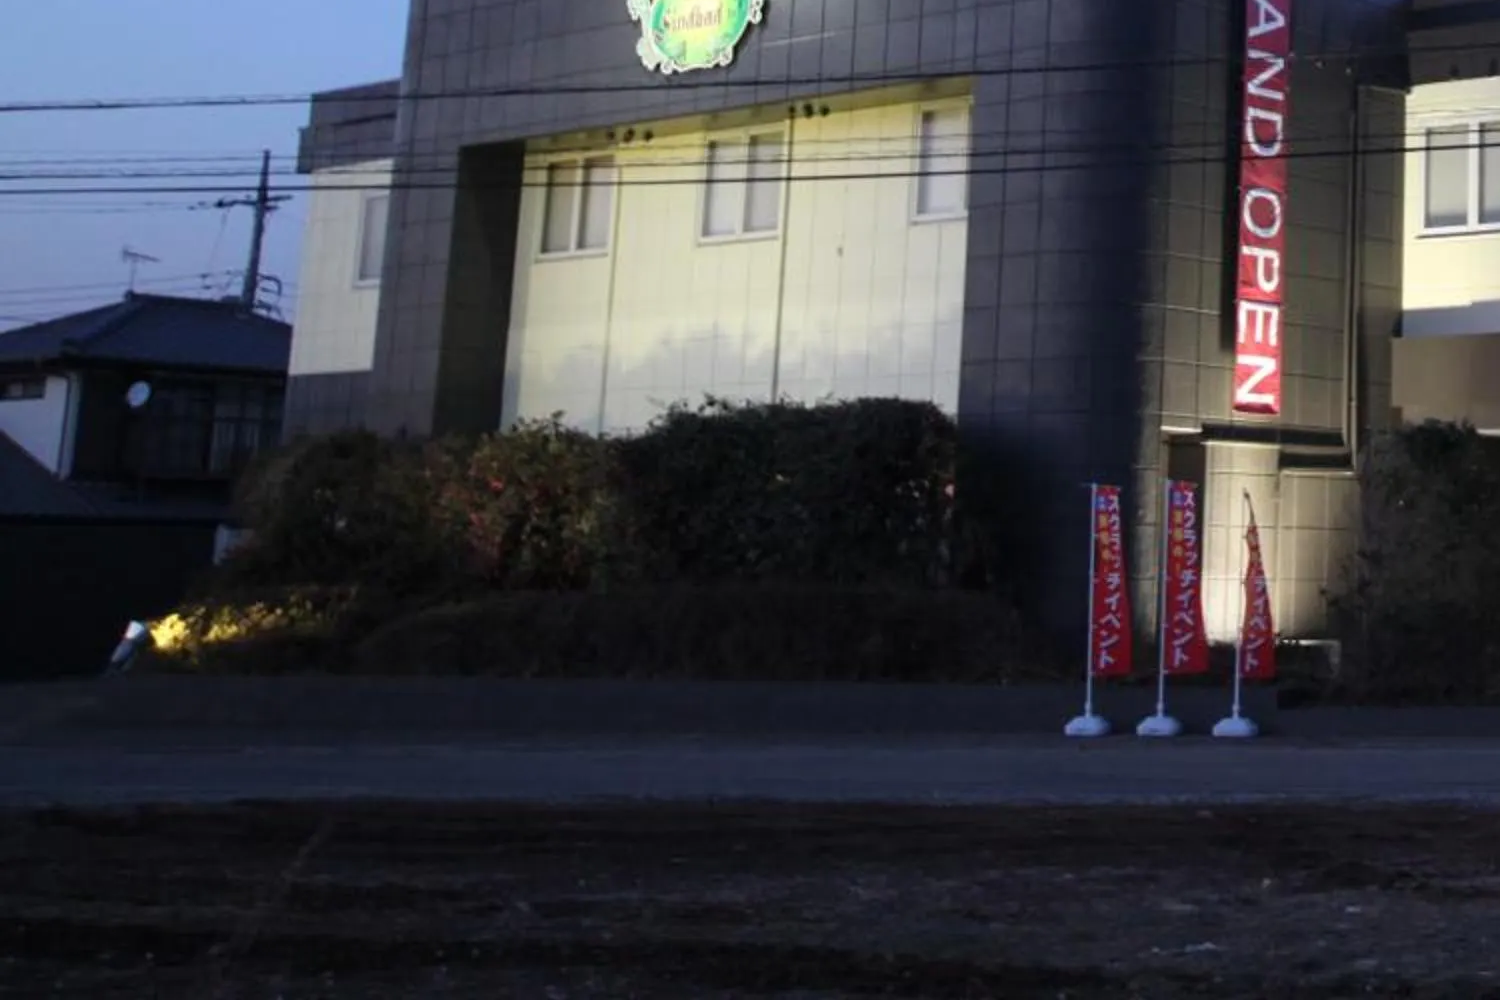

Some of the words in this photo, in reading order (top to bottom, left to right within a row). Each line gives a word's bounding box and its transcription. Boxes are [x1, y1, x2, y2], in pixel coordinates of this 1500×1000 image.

[1235, 189, 1281, 405] OPEN
[1172, 490, 1197, 668] スクラッチイベント
